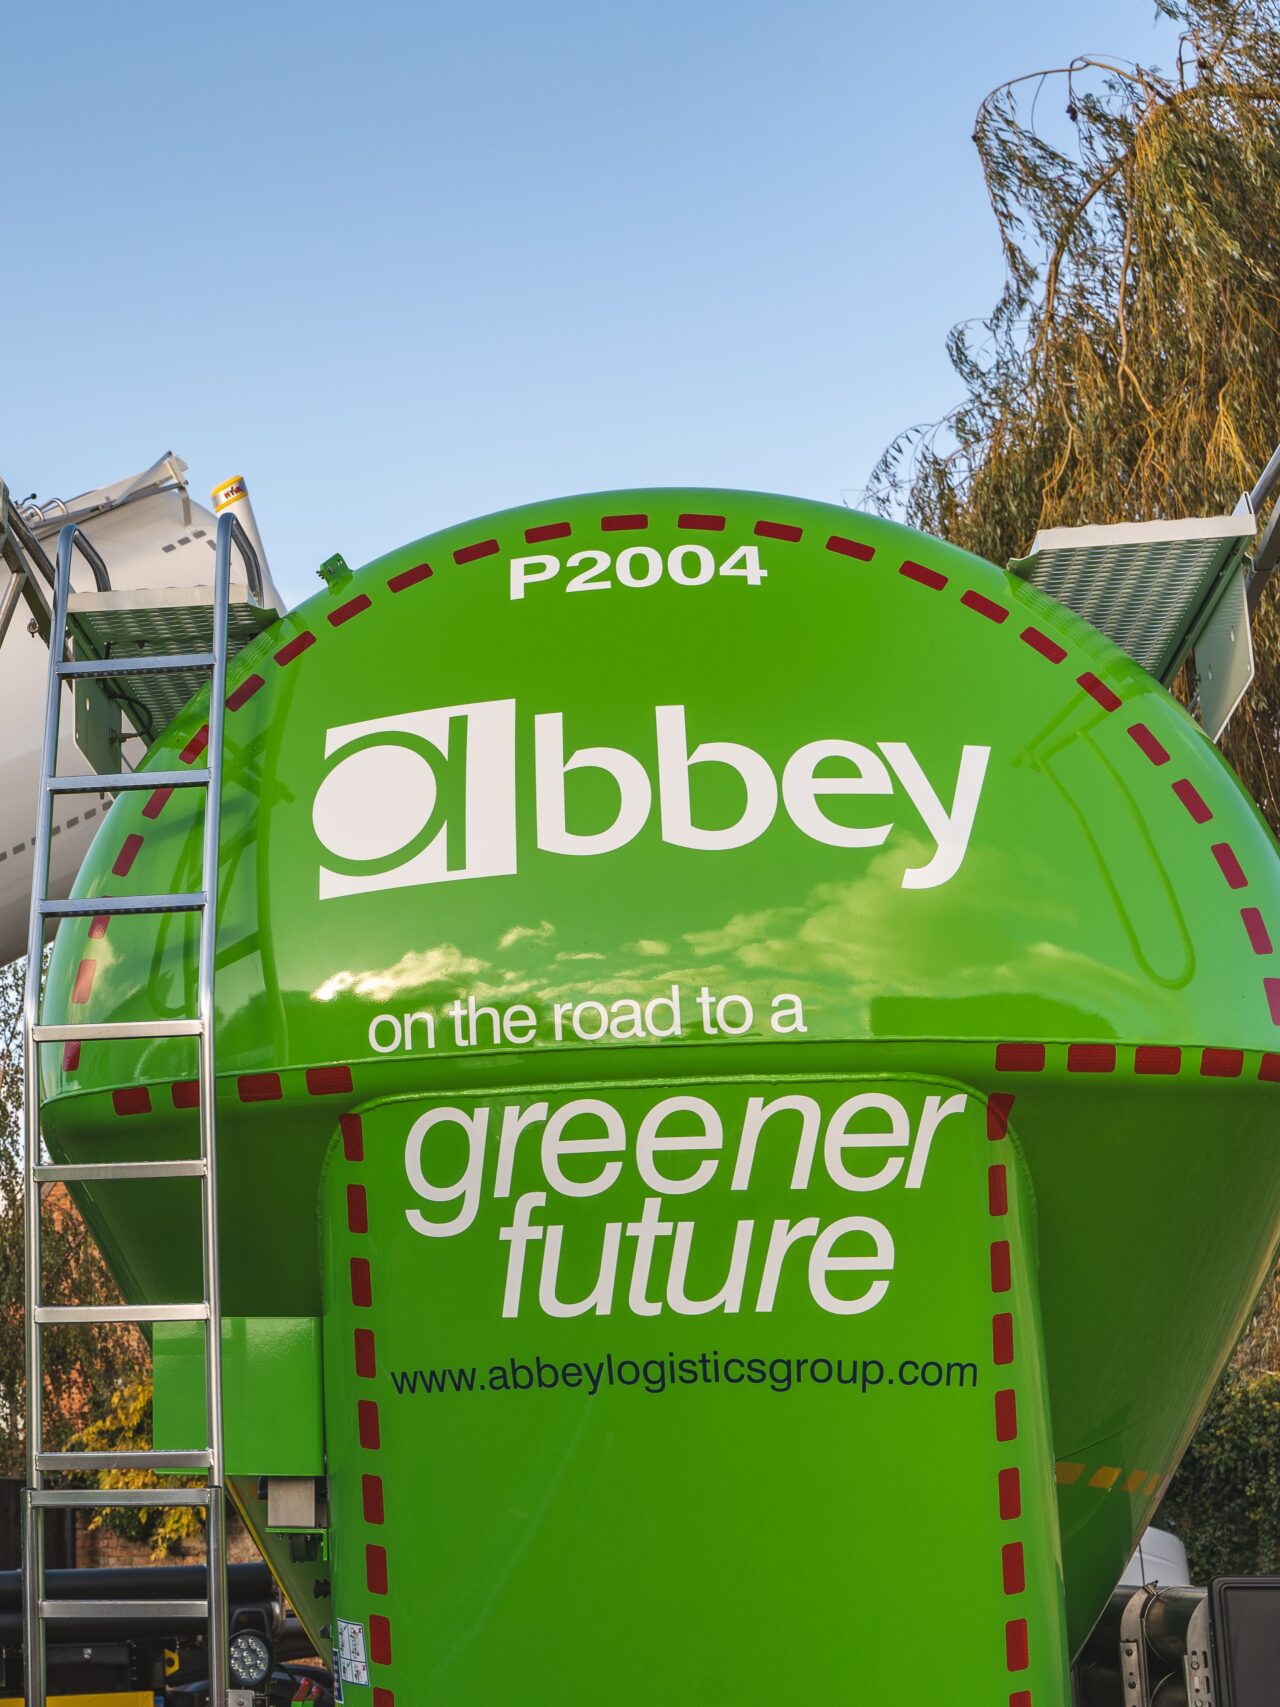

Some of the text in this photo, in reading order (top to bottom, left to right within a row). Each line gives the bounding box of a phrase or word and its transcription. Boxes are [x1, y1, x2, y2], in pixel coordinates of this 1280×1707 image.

[510, 544, 768, 601] P2004
[312, 699, 991, 901] abbey
[368, 985, 808, 1052] on the road to a
[404, 1093, 968, 1238] greener
[499, 1191, 895, 1318] future
[390, 1350, 978, 1396] www.abbeylogisticsgroup.com
